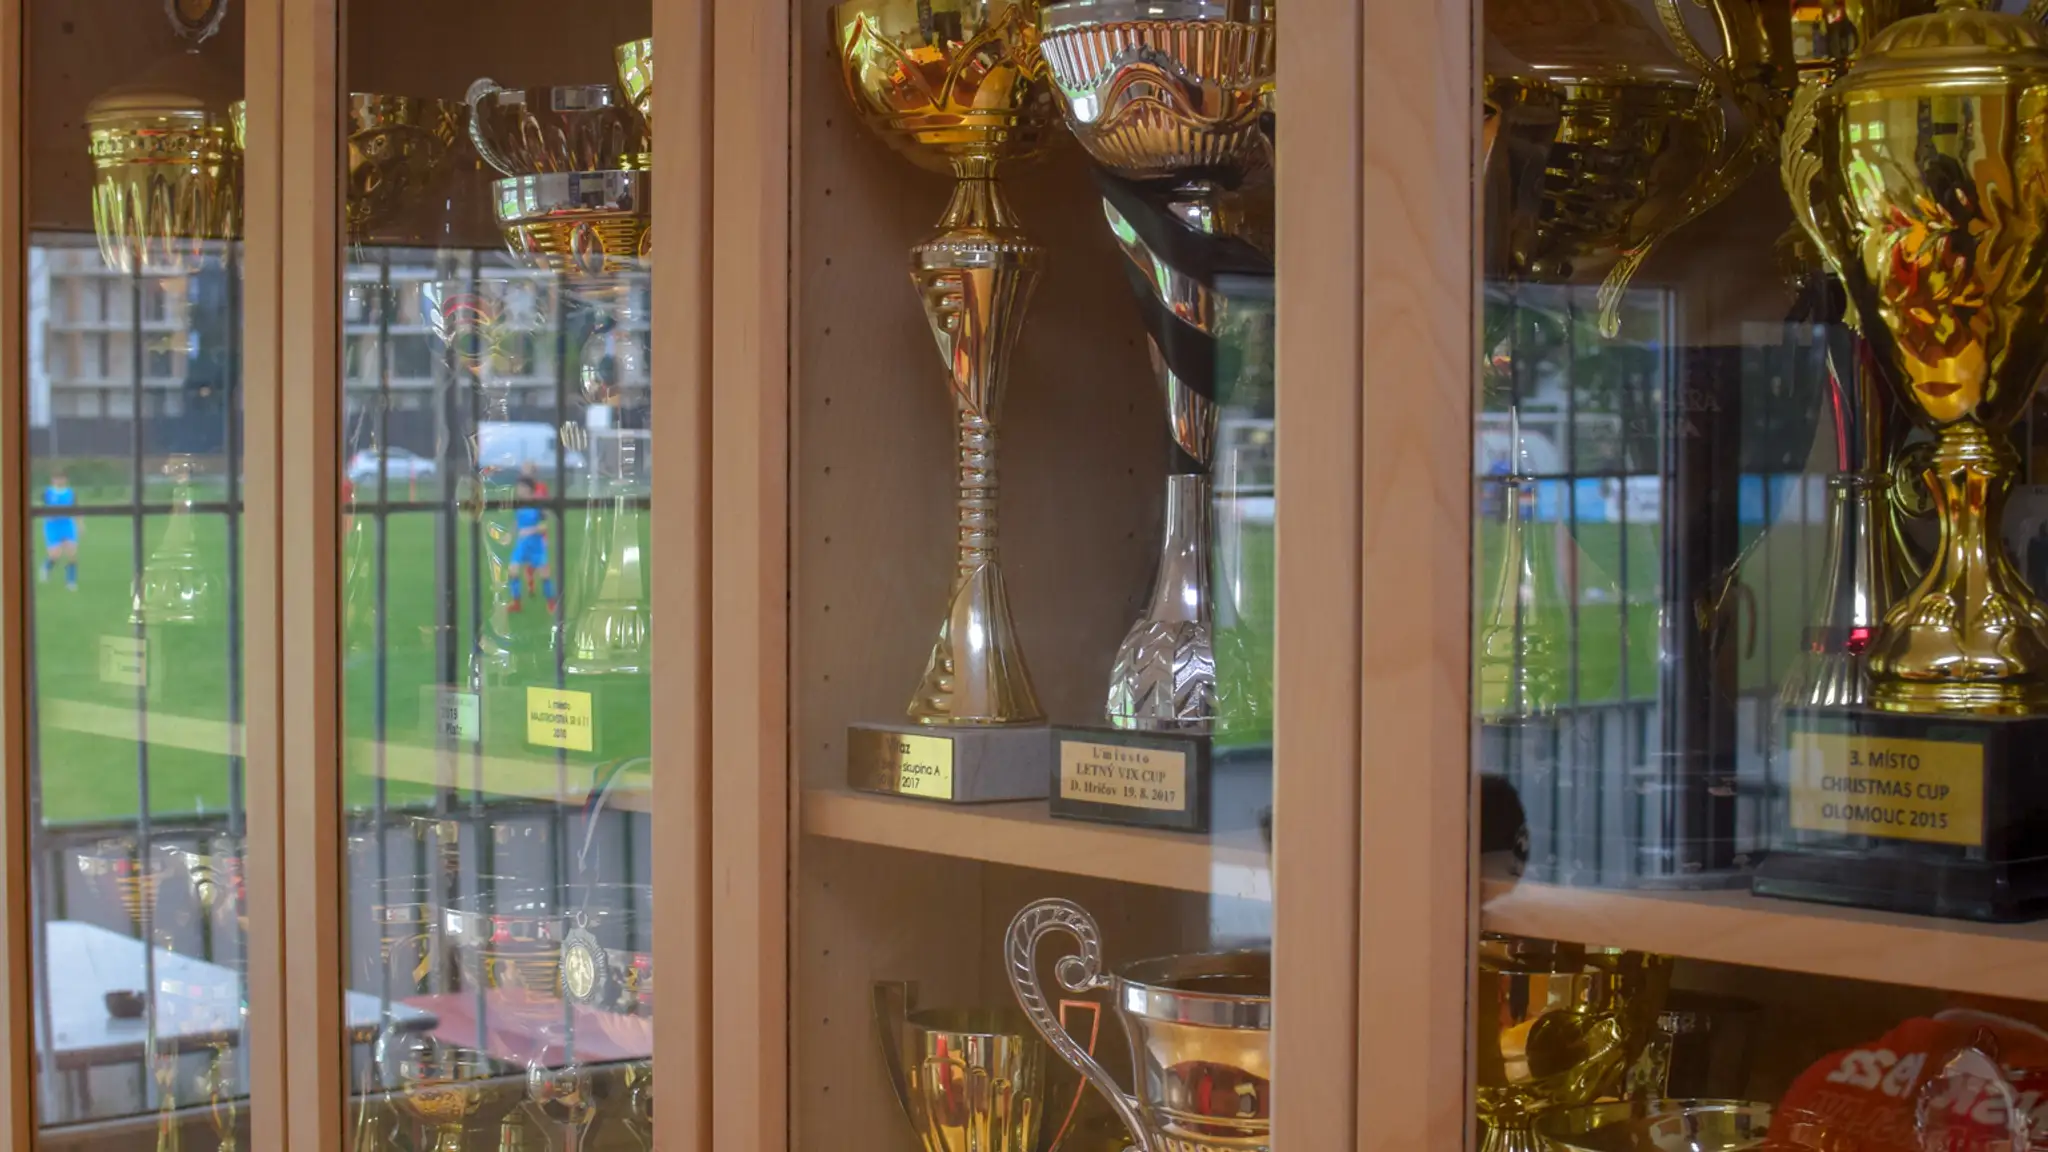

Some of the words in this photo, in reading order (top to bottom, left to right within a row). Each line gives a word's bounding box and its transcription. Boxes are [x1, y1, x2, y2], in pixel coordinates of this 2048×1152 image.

[934, 765, 941, 776] A
[1850, 751, 1863, 766] 3.
[1868, 748, 1920, 771] MÍSTO
[1076, 763, 1115, 778] LETNÝ
[1142, 770, 1167, 783] CUP
[1070, 780, 1081, 792] D.
[1151, 789, 1176, 803] 2017
[1821, 776, 1913, 798] CHRISTMAS
[1917, 783, 1950, 801] CUP
[1821, 803, 1906, 826] OLOMOUC
[1910, 811, 1948, 829] 2015
